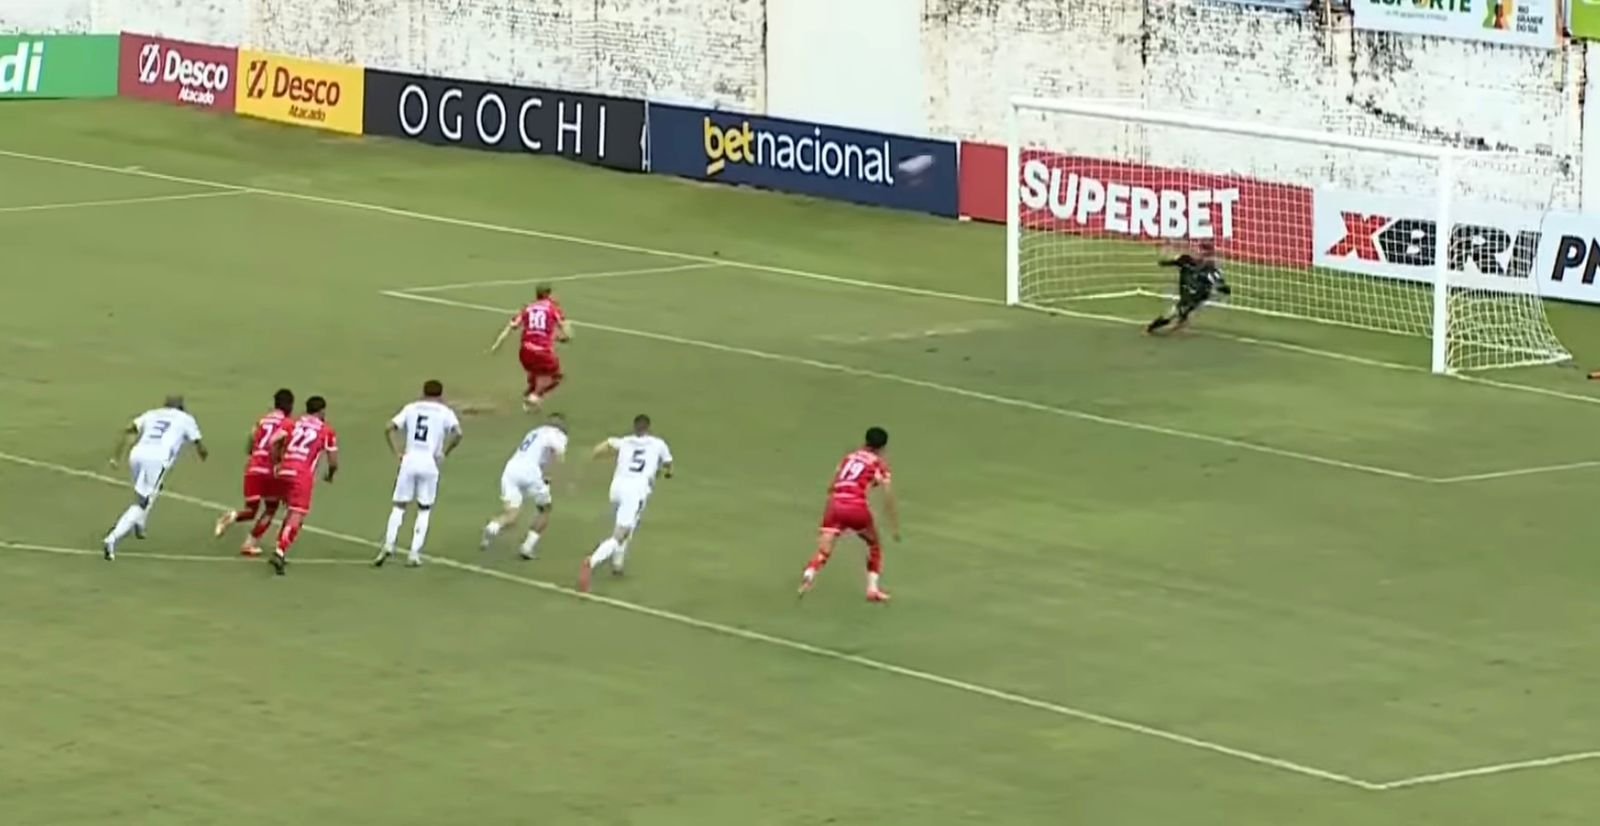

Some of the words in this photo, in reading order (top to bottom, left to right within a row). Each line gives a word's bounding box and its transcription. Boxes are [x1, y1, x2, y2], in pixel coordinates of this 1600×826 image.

[163, 50, 228, 91] Desco
[272, 67, 340, 107] Desco
[178, 85, 215, 105] Atacado
[288, 104, 327, 122] Atacado
[398, 83, 607, 158] OGOCHI
[703, 116, 894, 185] betnacional
[1020, 160, 1240, 242] SUPERBET
[1325, 211, 1543, 278] XBRI
[258, 424, 273, 448] 7
[287, 427, 317, 454] 22
[629, 449, 647, 473] 5
